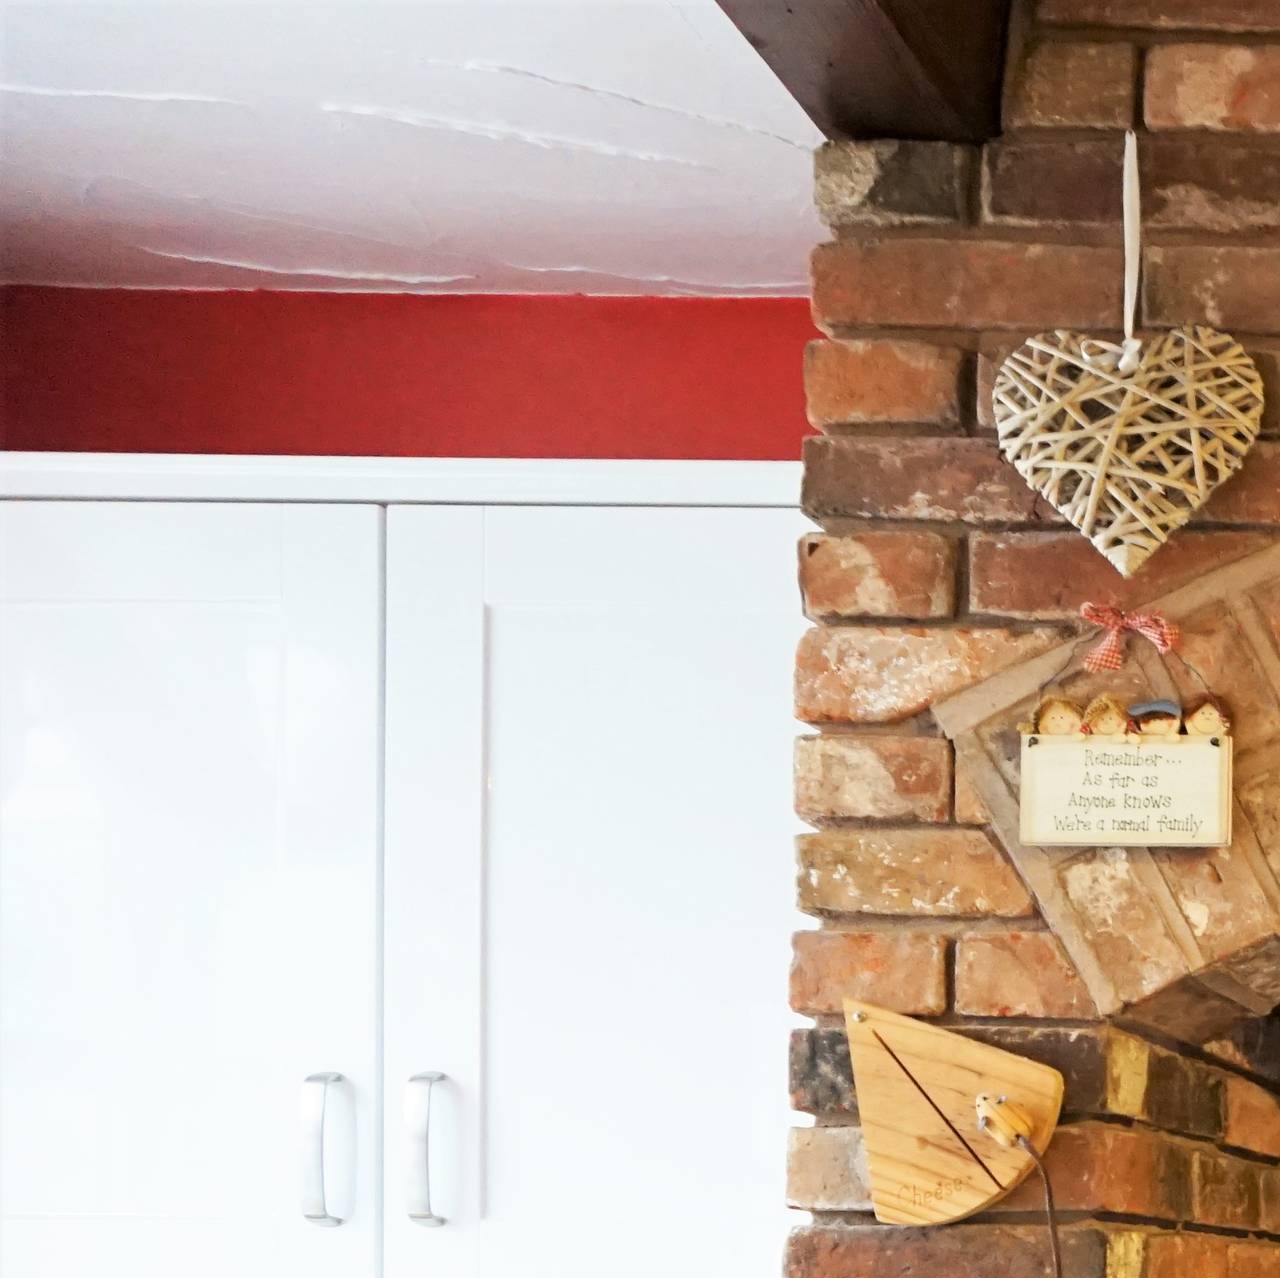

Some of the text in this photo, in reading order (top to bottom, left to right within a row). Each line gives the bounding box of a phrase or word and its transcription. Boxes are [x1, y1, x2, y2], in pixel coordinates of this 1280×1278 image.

[1082, 771, 1159, 788] As far as
[1067, 792, 1116, 814] Anyone
[1096, 819, 1105, 831] a
[1111, 815, 1151, 832] normal
[1156, 813, 1204, 838] family
